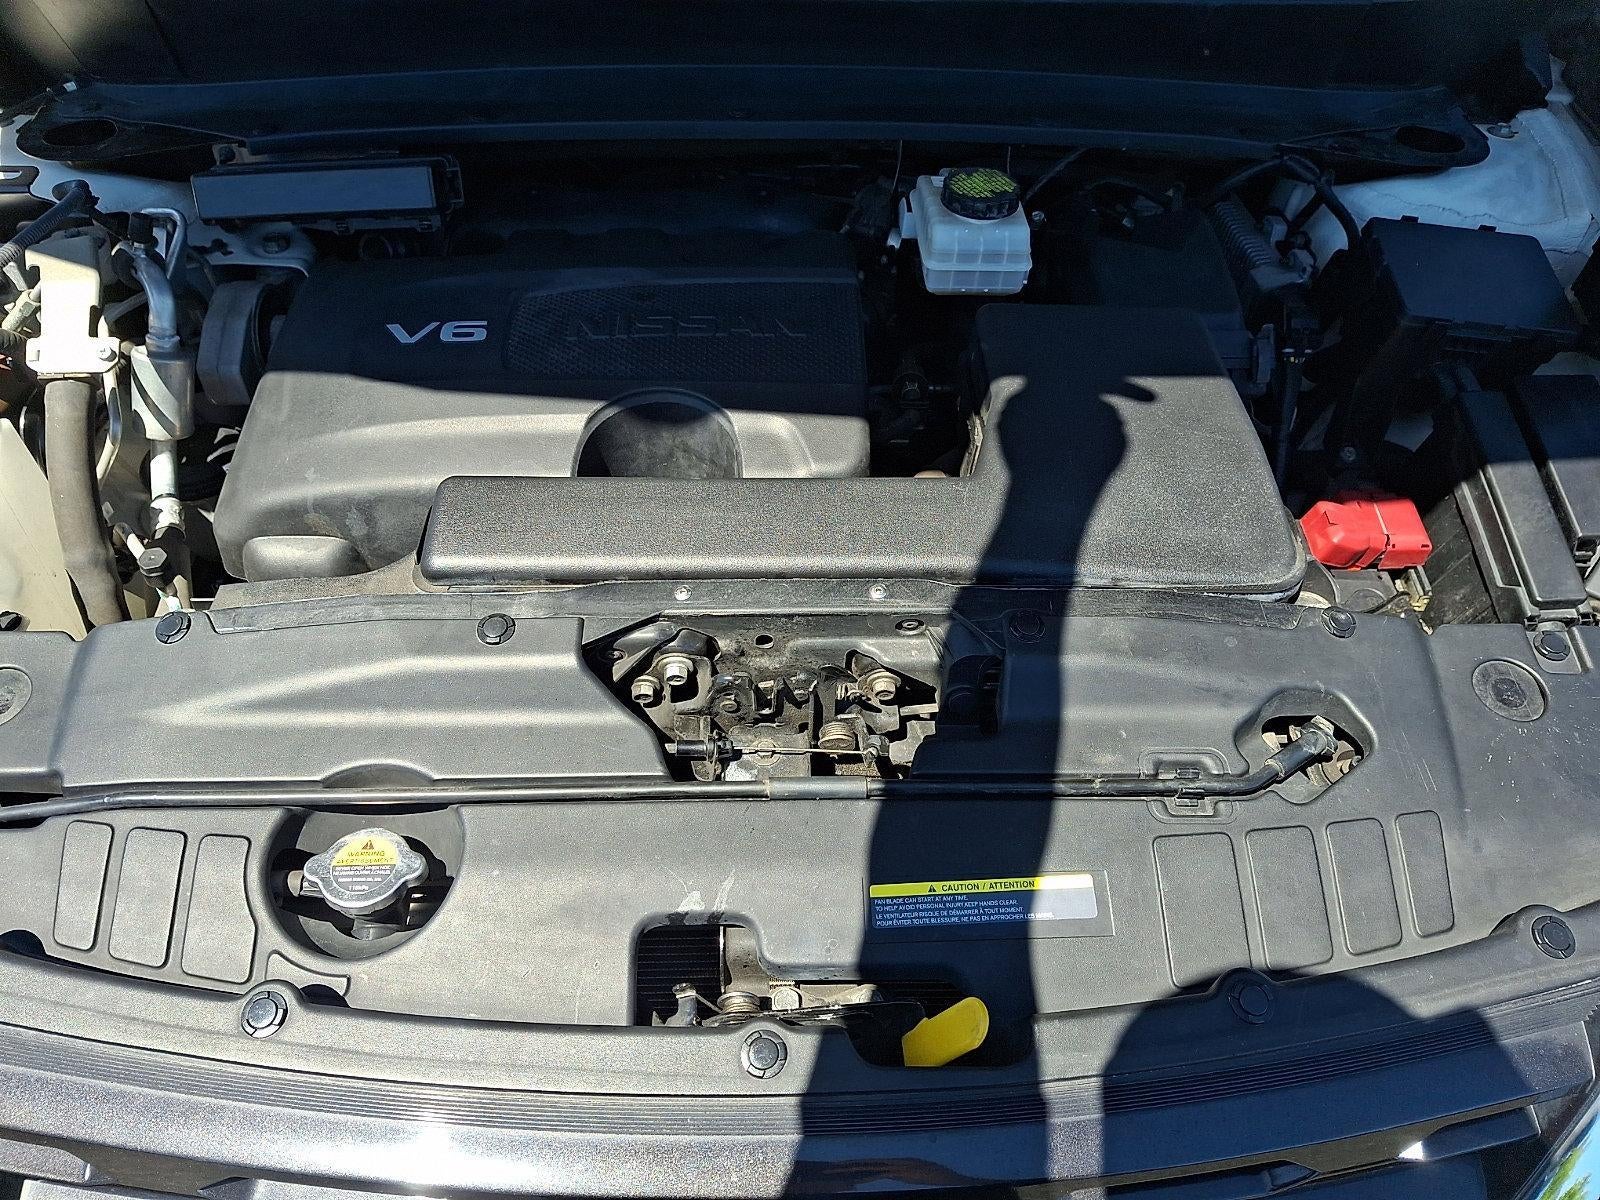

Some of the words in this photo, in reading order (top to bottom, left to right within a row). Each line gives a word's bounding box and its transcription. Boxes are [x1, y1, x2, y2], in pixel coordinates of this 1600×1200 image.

[562, 311, 809, 340] NISSAN
[385, 321, 489, 343] V6
[941, 883, 980, 892] CAUTION
[988, 880, 1035, 890] ATTENTION
[948, 908, 979, 916] DÉMARRER
[893, 918, 912, 926] ÉVITER
